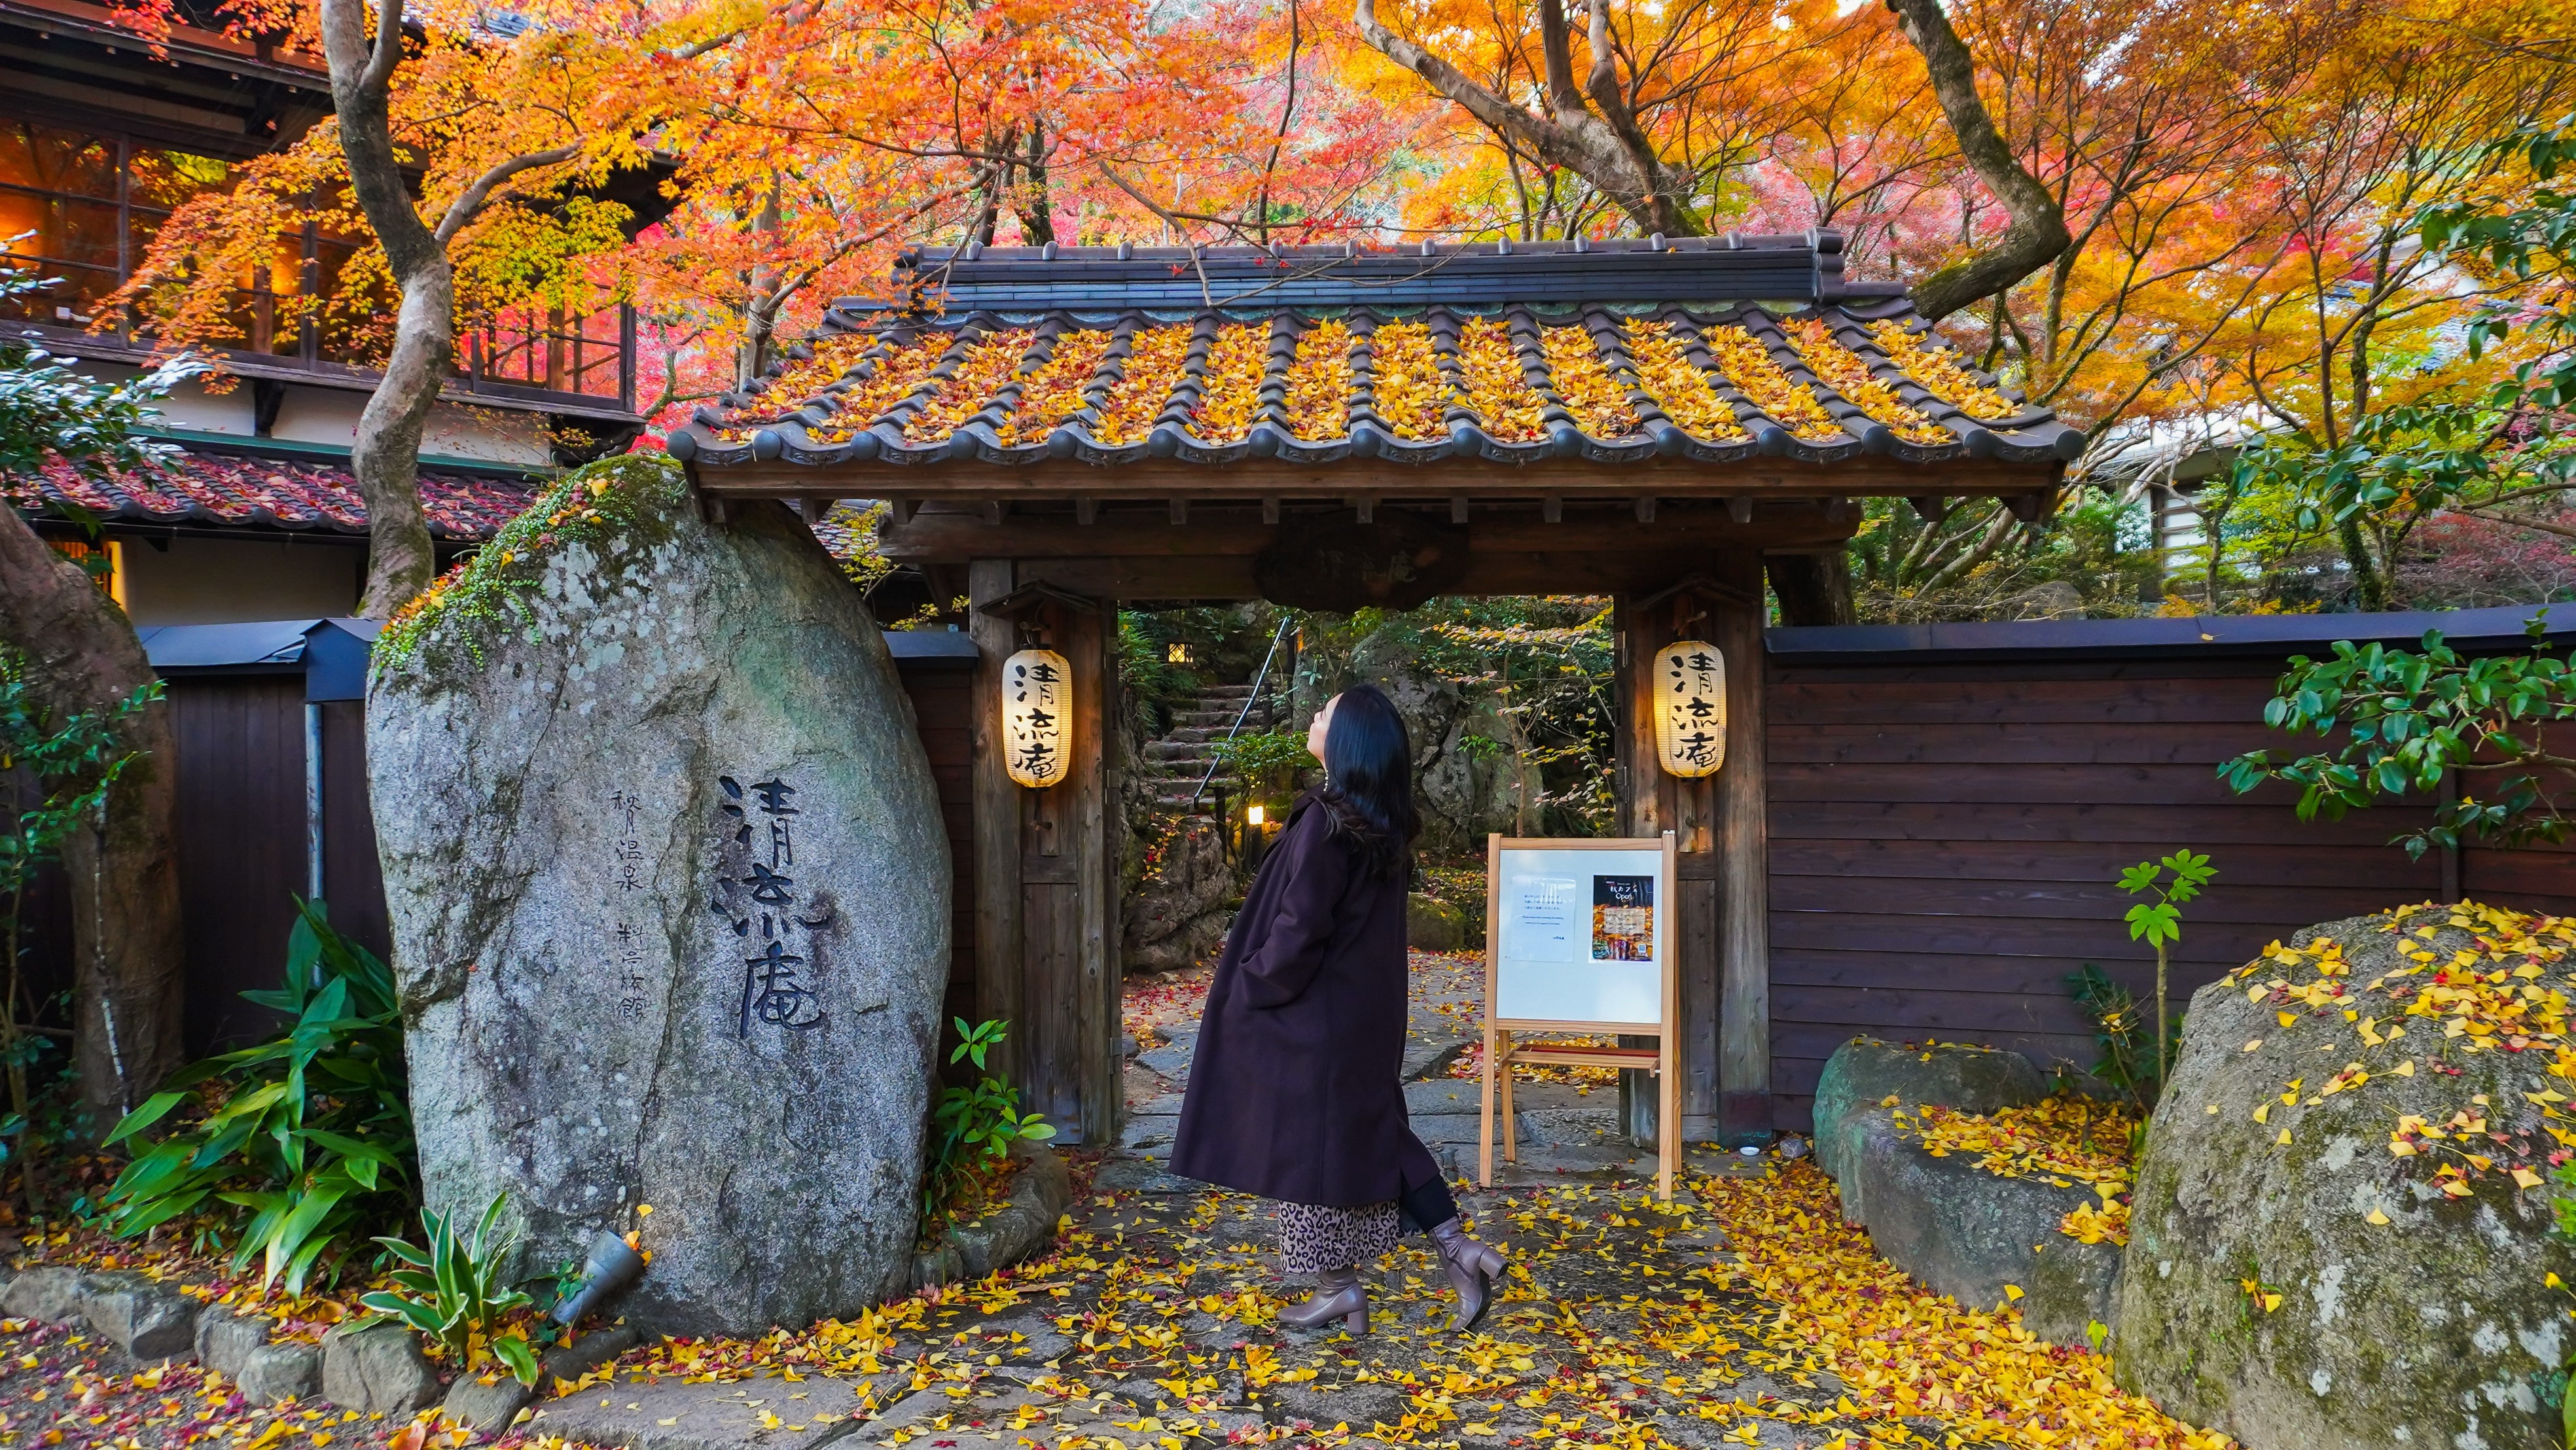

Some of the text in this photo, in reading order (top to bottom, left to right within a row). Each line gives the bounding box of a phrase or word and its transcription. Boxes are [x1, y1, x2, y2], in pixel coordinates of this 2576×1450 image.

[1013, 663, 1060, 779] 清流庵
[1670, 652, 1718, 768] 清流庵
[711, 775, 832, 1039] 清流庵
